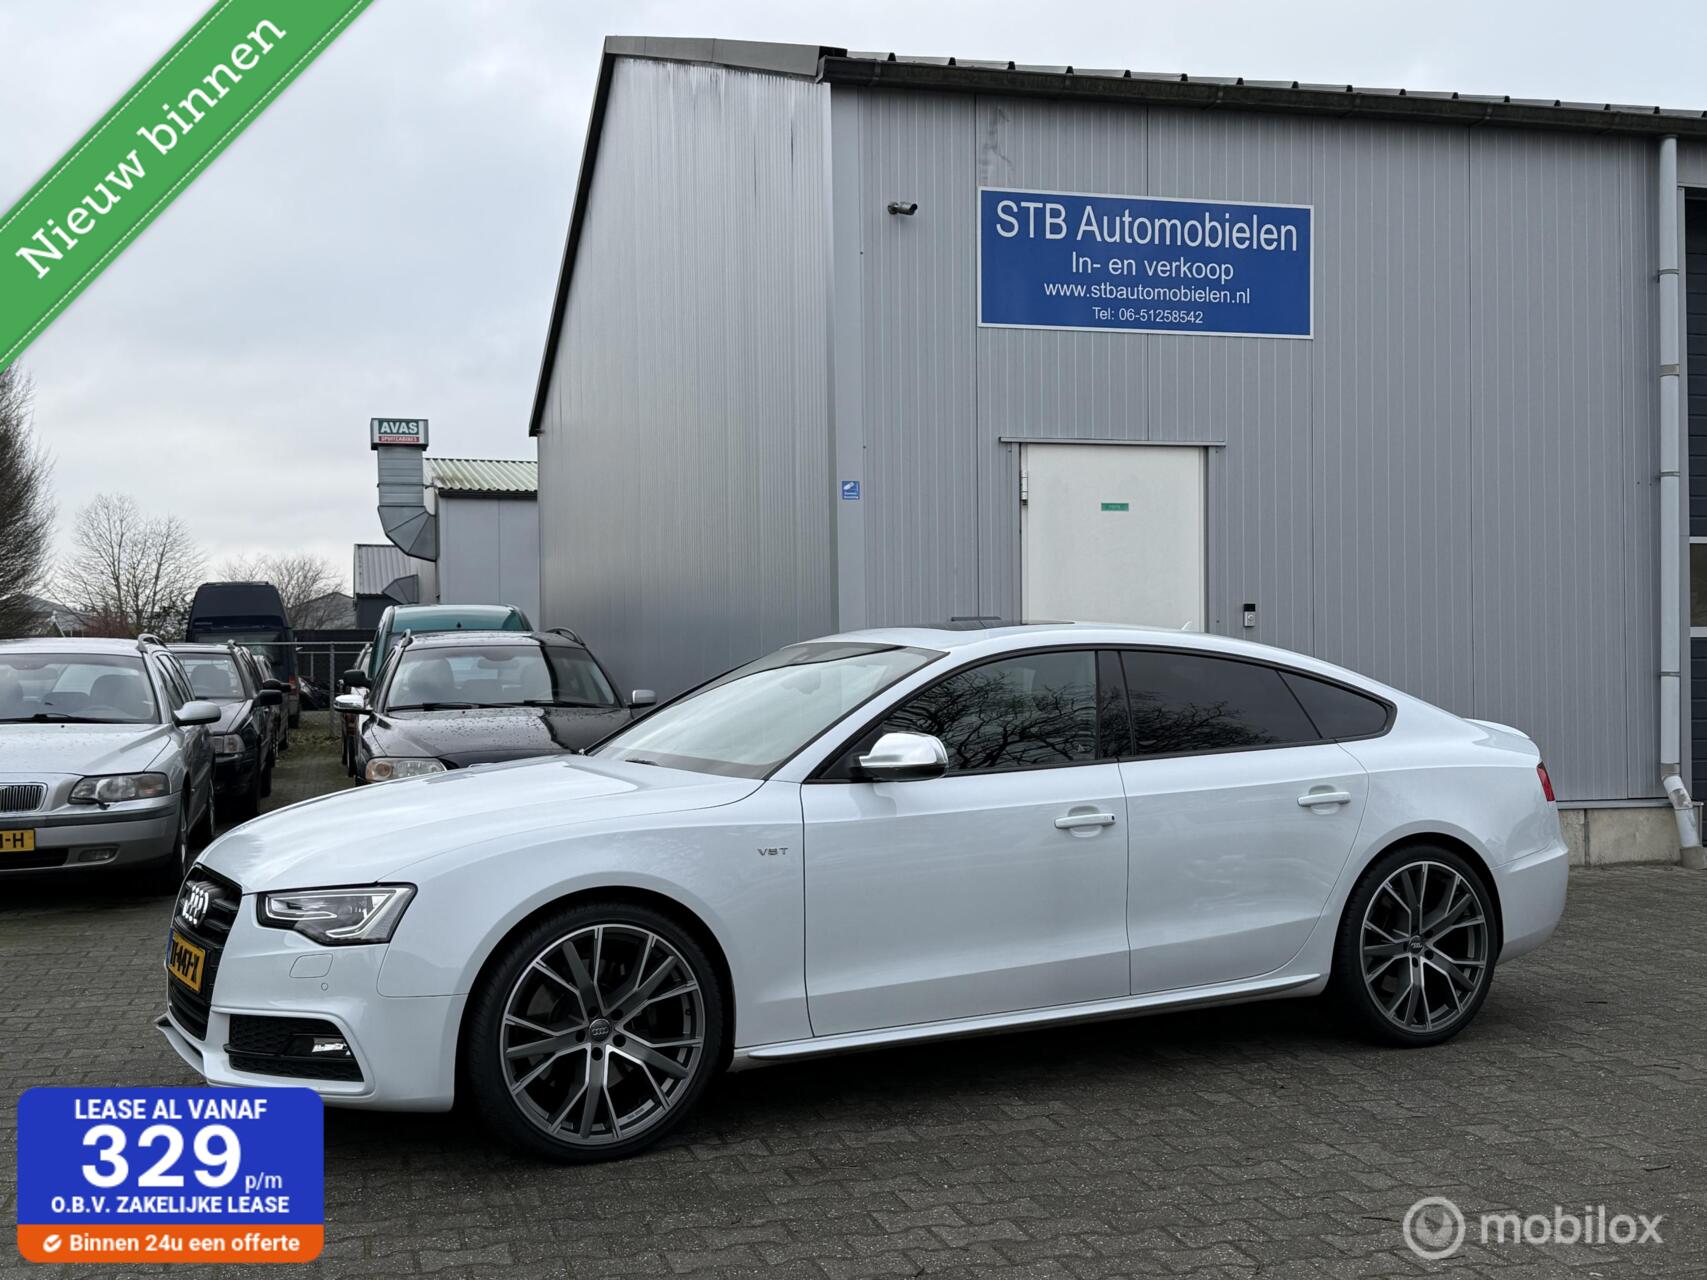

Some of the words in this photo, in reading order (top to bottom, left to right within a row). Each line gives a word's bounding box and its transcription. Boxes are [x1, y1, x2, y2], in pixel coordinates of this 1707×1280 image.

[996, 200, 1067, 240] STB
[1076, 205, 1297, 251] Automobielen
[1072, 251, 1101, 274] In-
[1108, 258, 1136, 276] en
[1144, 257, 1234, 284] verkoop
[1044, 282, 1250, 304] www.stbautomobielen.nl
[1092, 306, 1115, 321] Tel:
[1118, 308, 1204, 324] 06-51258542
[380, 421, 418, 434] AVAS
